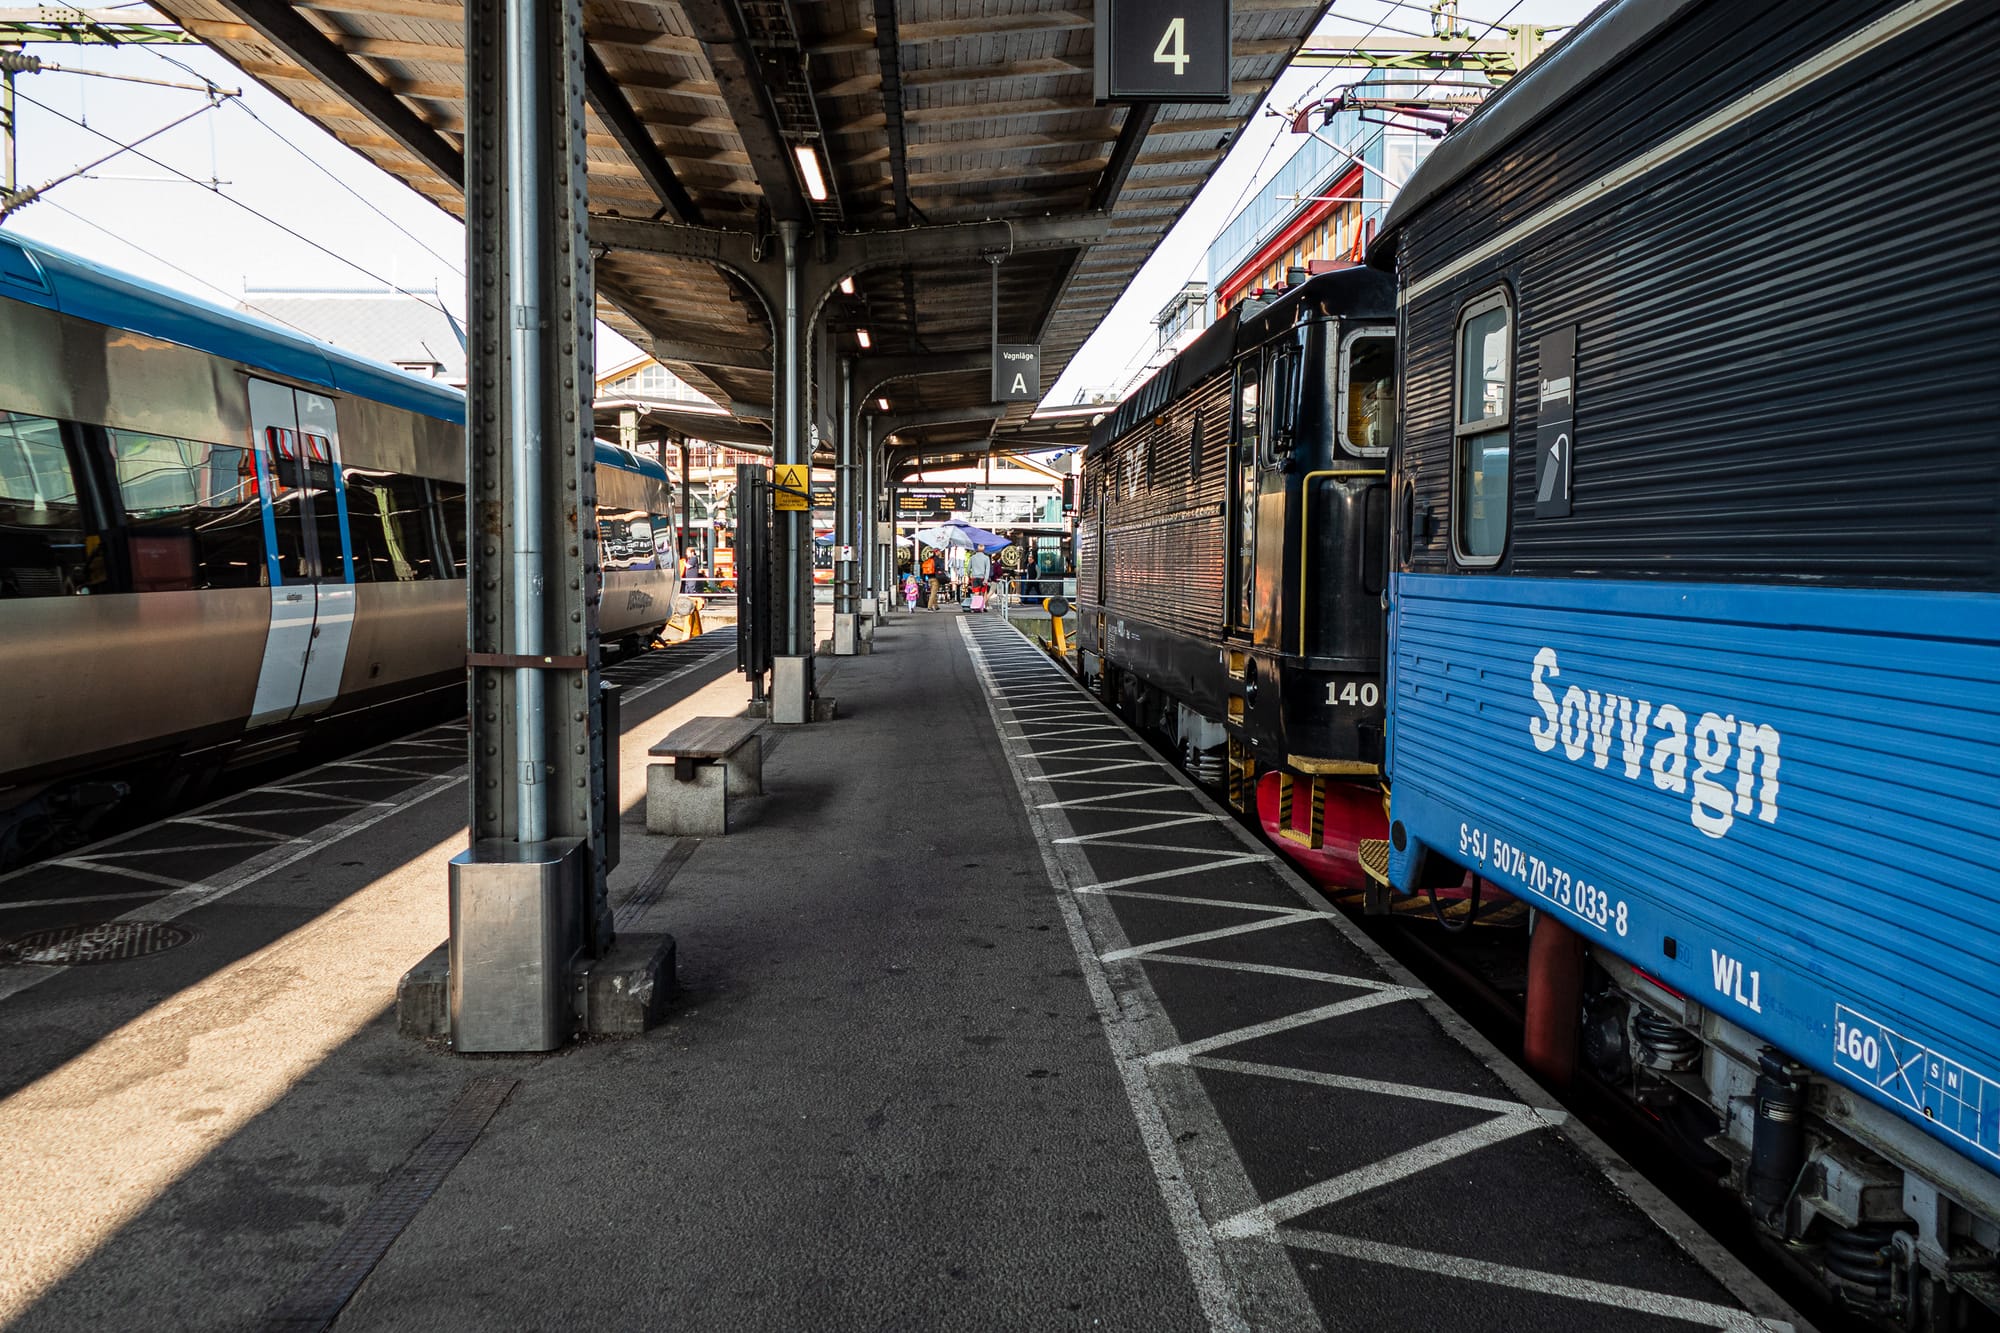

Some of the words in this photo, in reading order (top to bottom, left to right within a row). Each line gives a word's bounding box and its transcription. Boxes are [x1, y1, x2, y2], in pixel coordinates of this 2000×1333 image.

[1153, 17, 1190, 76] 4
[1003, 352, 1034, 361] Vagnläge
[1010, 373, 1028, 394] A
[307, 396, 326, 412] A
[1325, 681, 1379, 707] 140
[1529, 647, 1782, 839] Sovvagn
[1460, 823, 1487, 861] S-SJ
[1575, 880, 1628, 937] 033-8
[1710, 949, 1761, 1014] WL1
[1836, 1022, 1878, 1070] 160
[1931, 1063, 1938, 1079] S
[1948, 1073, 1957, 1089] N
